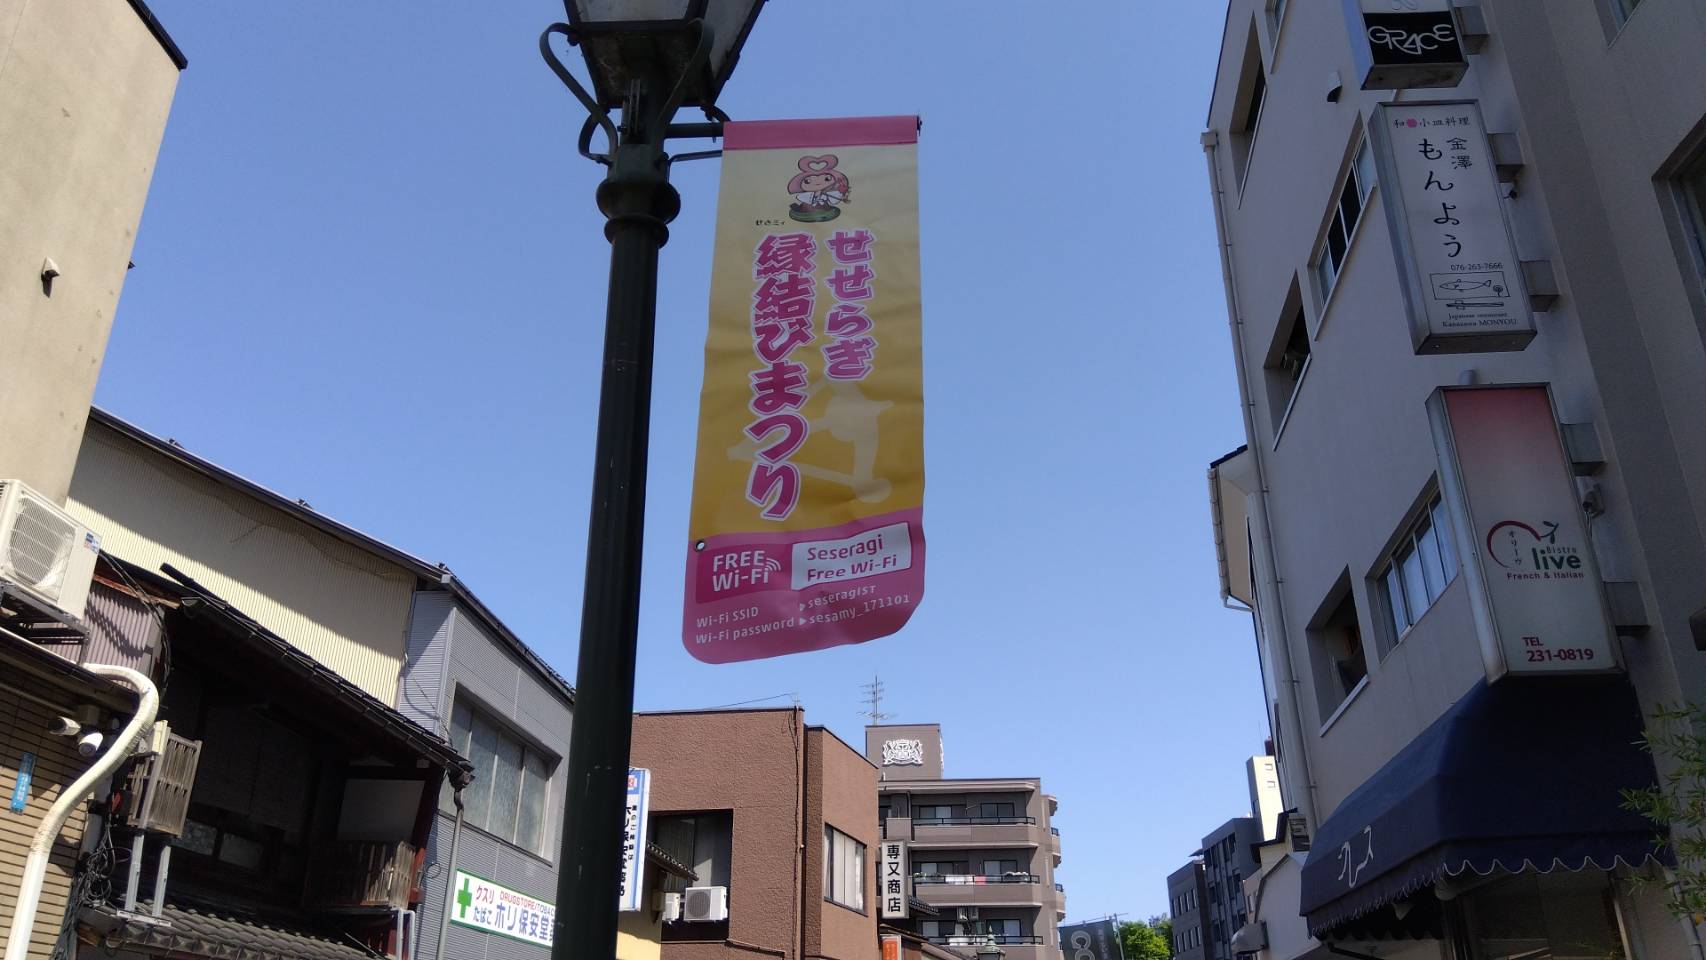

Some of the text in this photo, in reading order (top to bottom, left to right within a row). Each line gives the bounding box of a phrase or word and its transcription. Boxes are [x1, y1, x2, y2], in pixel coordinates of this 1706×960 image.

[1367, 23, 1456, 55] GRACE
[1446, 137, 1473, 170] 金澤
[1418, 138, 1462, 258] もんよう
[823, 230, 877, 380] せせらぎ
[744, 233, 816, 521] 縁結びまつり
[712, 550, 765, 572] FREE
[806, 534, 883, 561] Seseragi
[712, 568, 769, 592] Wi-Fi
[806, 555, 897, 582] Free Wi-Fi
[1507, 571, 1584, 581] French & Italian
[696, 606, 759, 629] Wi-Fi SSID
[809, 594, 910, 624] sesamy_171101
[695, 616, 795, 645] Wi-Fi password
[1522, 636, 1544, 647] TEL
[1527, 648, 1594, 663] 231-0819
[886, 844, 901, 912] 専又商店
[476, 885, 495, 904] クスリ
[473, 905, 493, 925] たばこ
